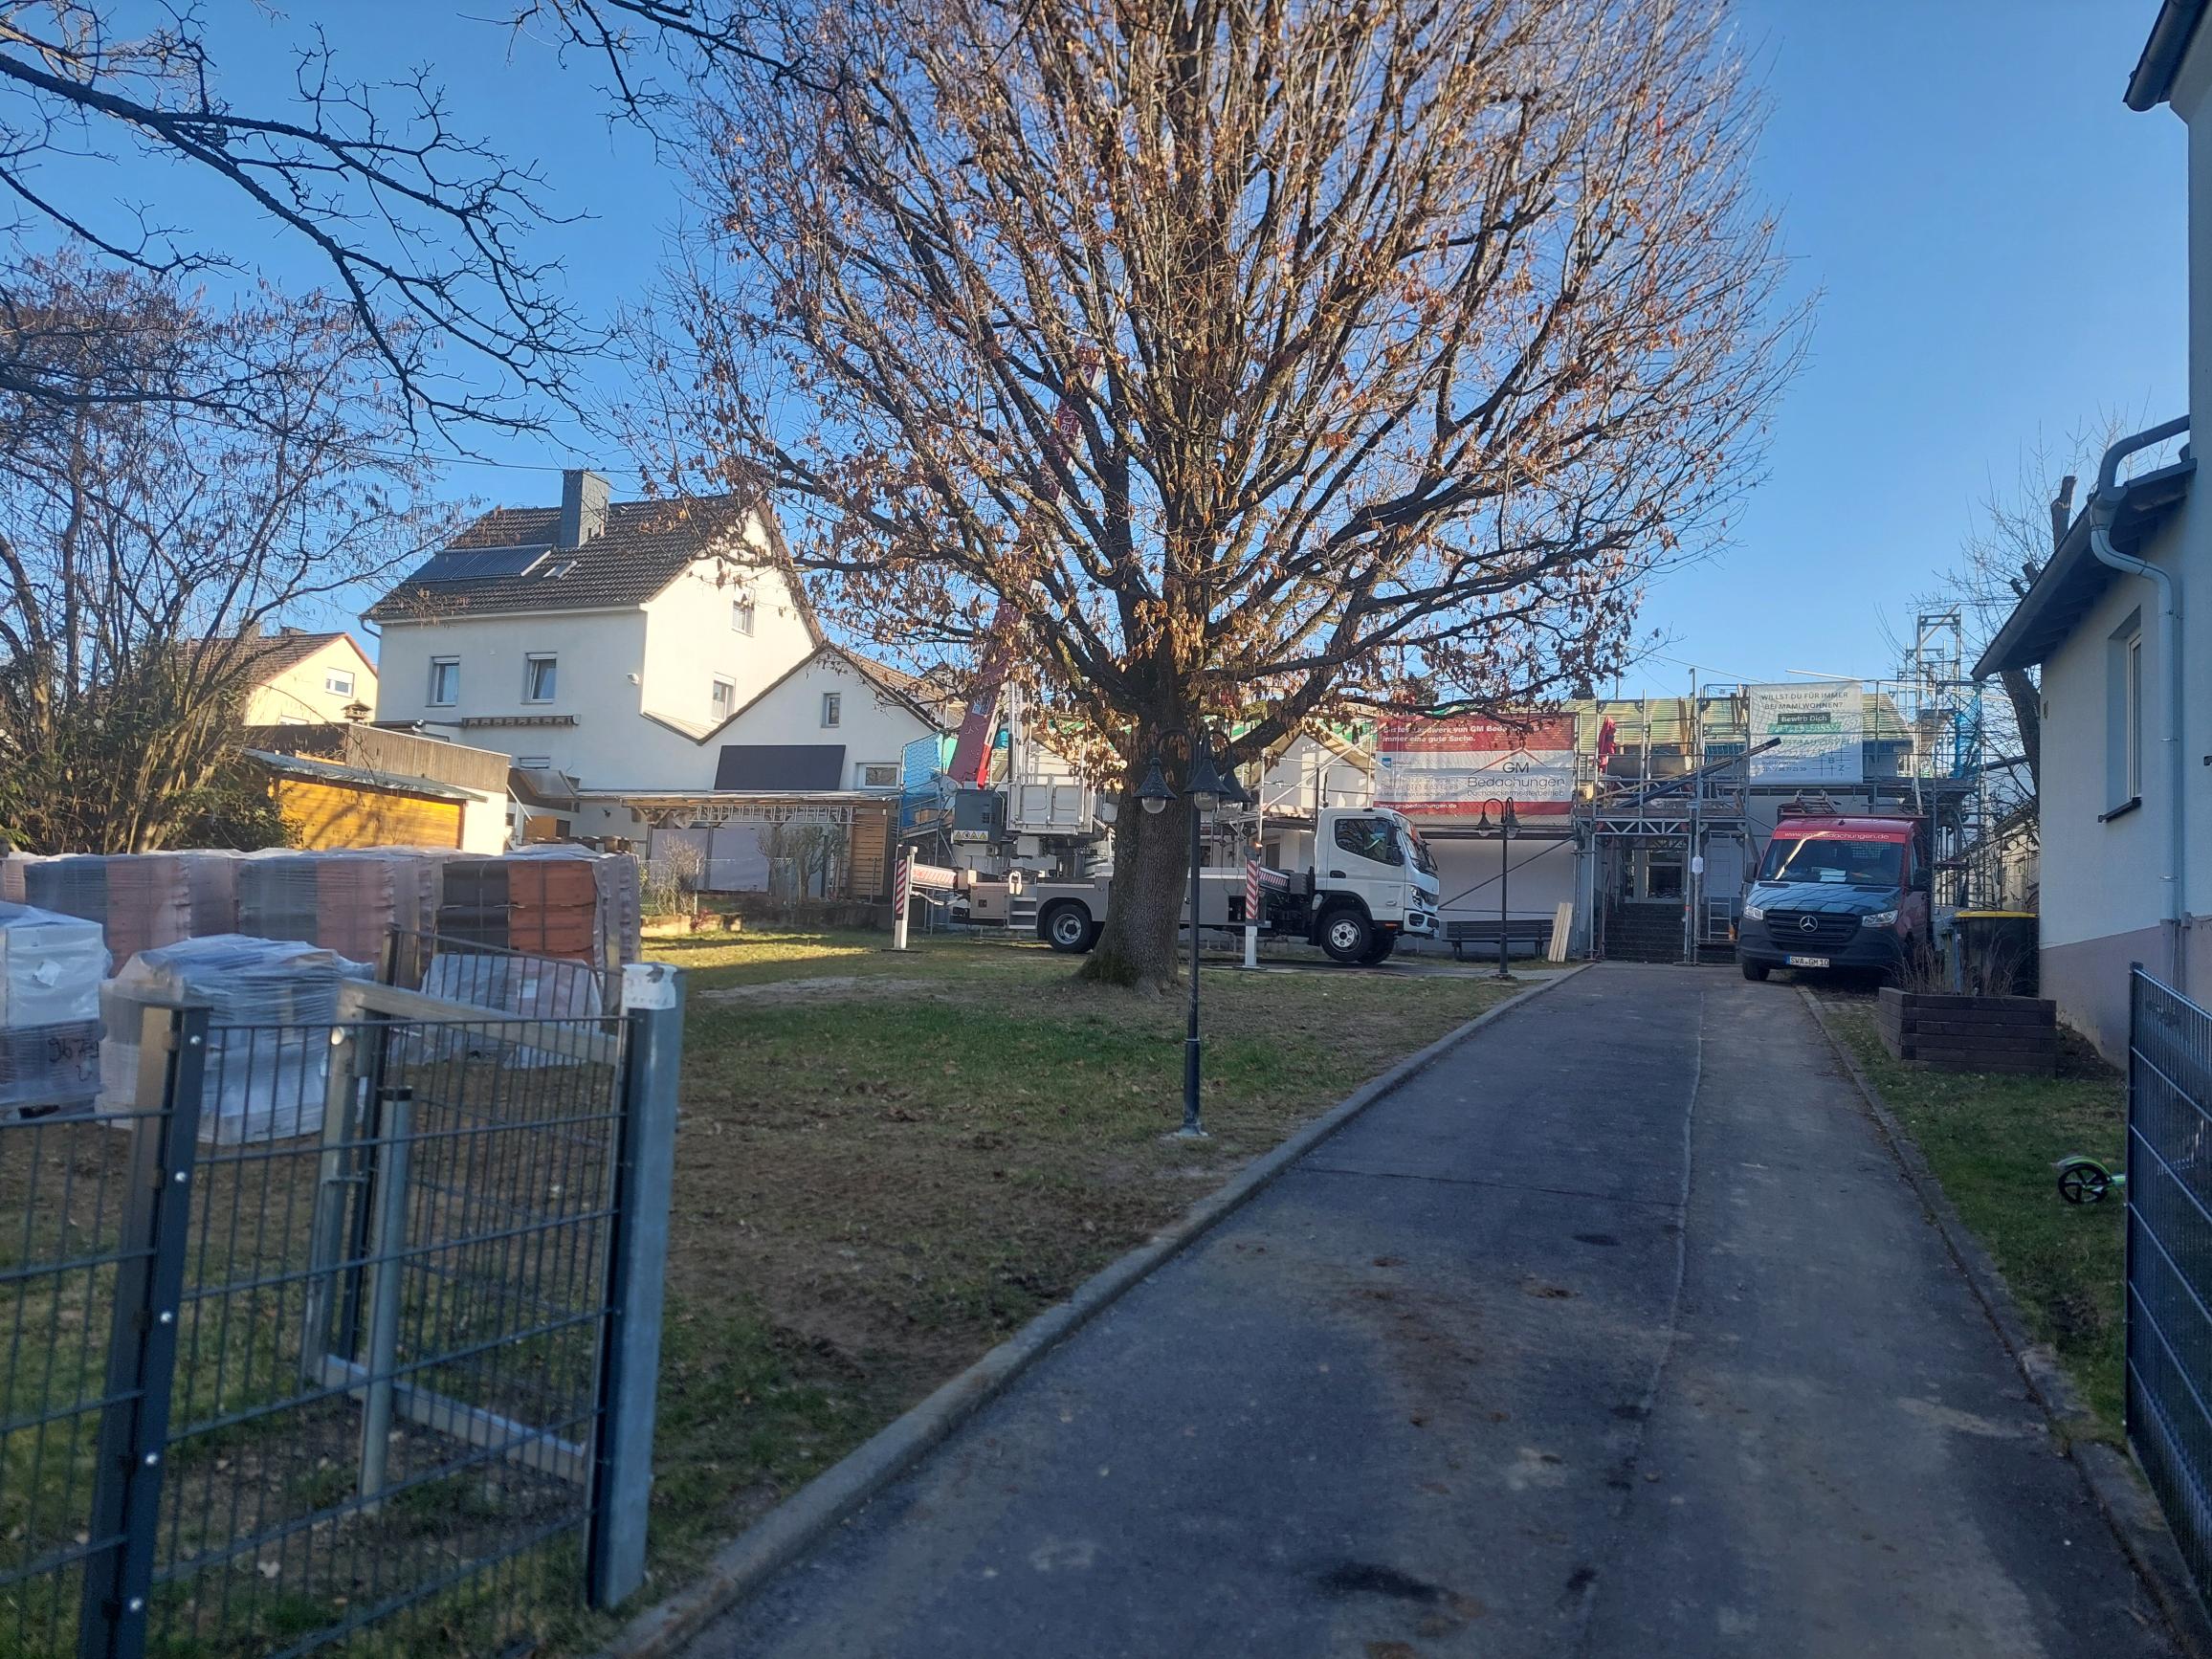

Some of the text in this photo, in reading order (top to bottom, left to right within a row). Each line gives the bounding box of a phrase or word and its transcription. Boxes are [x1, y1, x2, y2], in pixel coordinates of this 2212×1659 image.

[1502, 762, 1530, 774] GM
[1468, 776, 1565, 789] Bedachungen
[1784, 831, 1890, 840] www.gmedachungen.de
